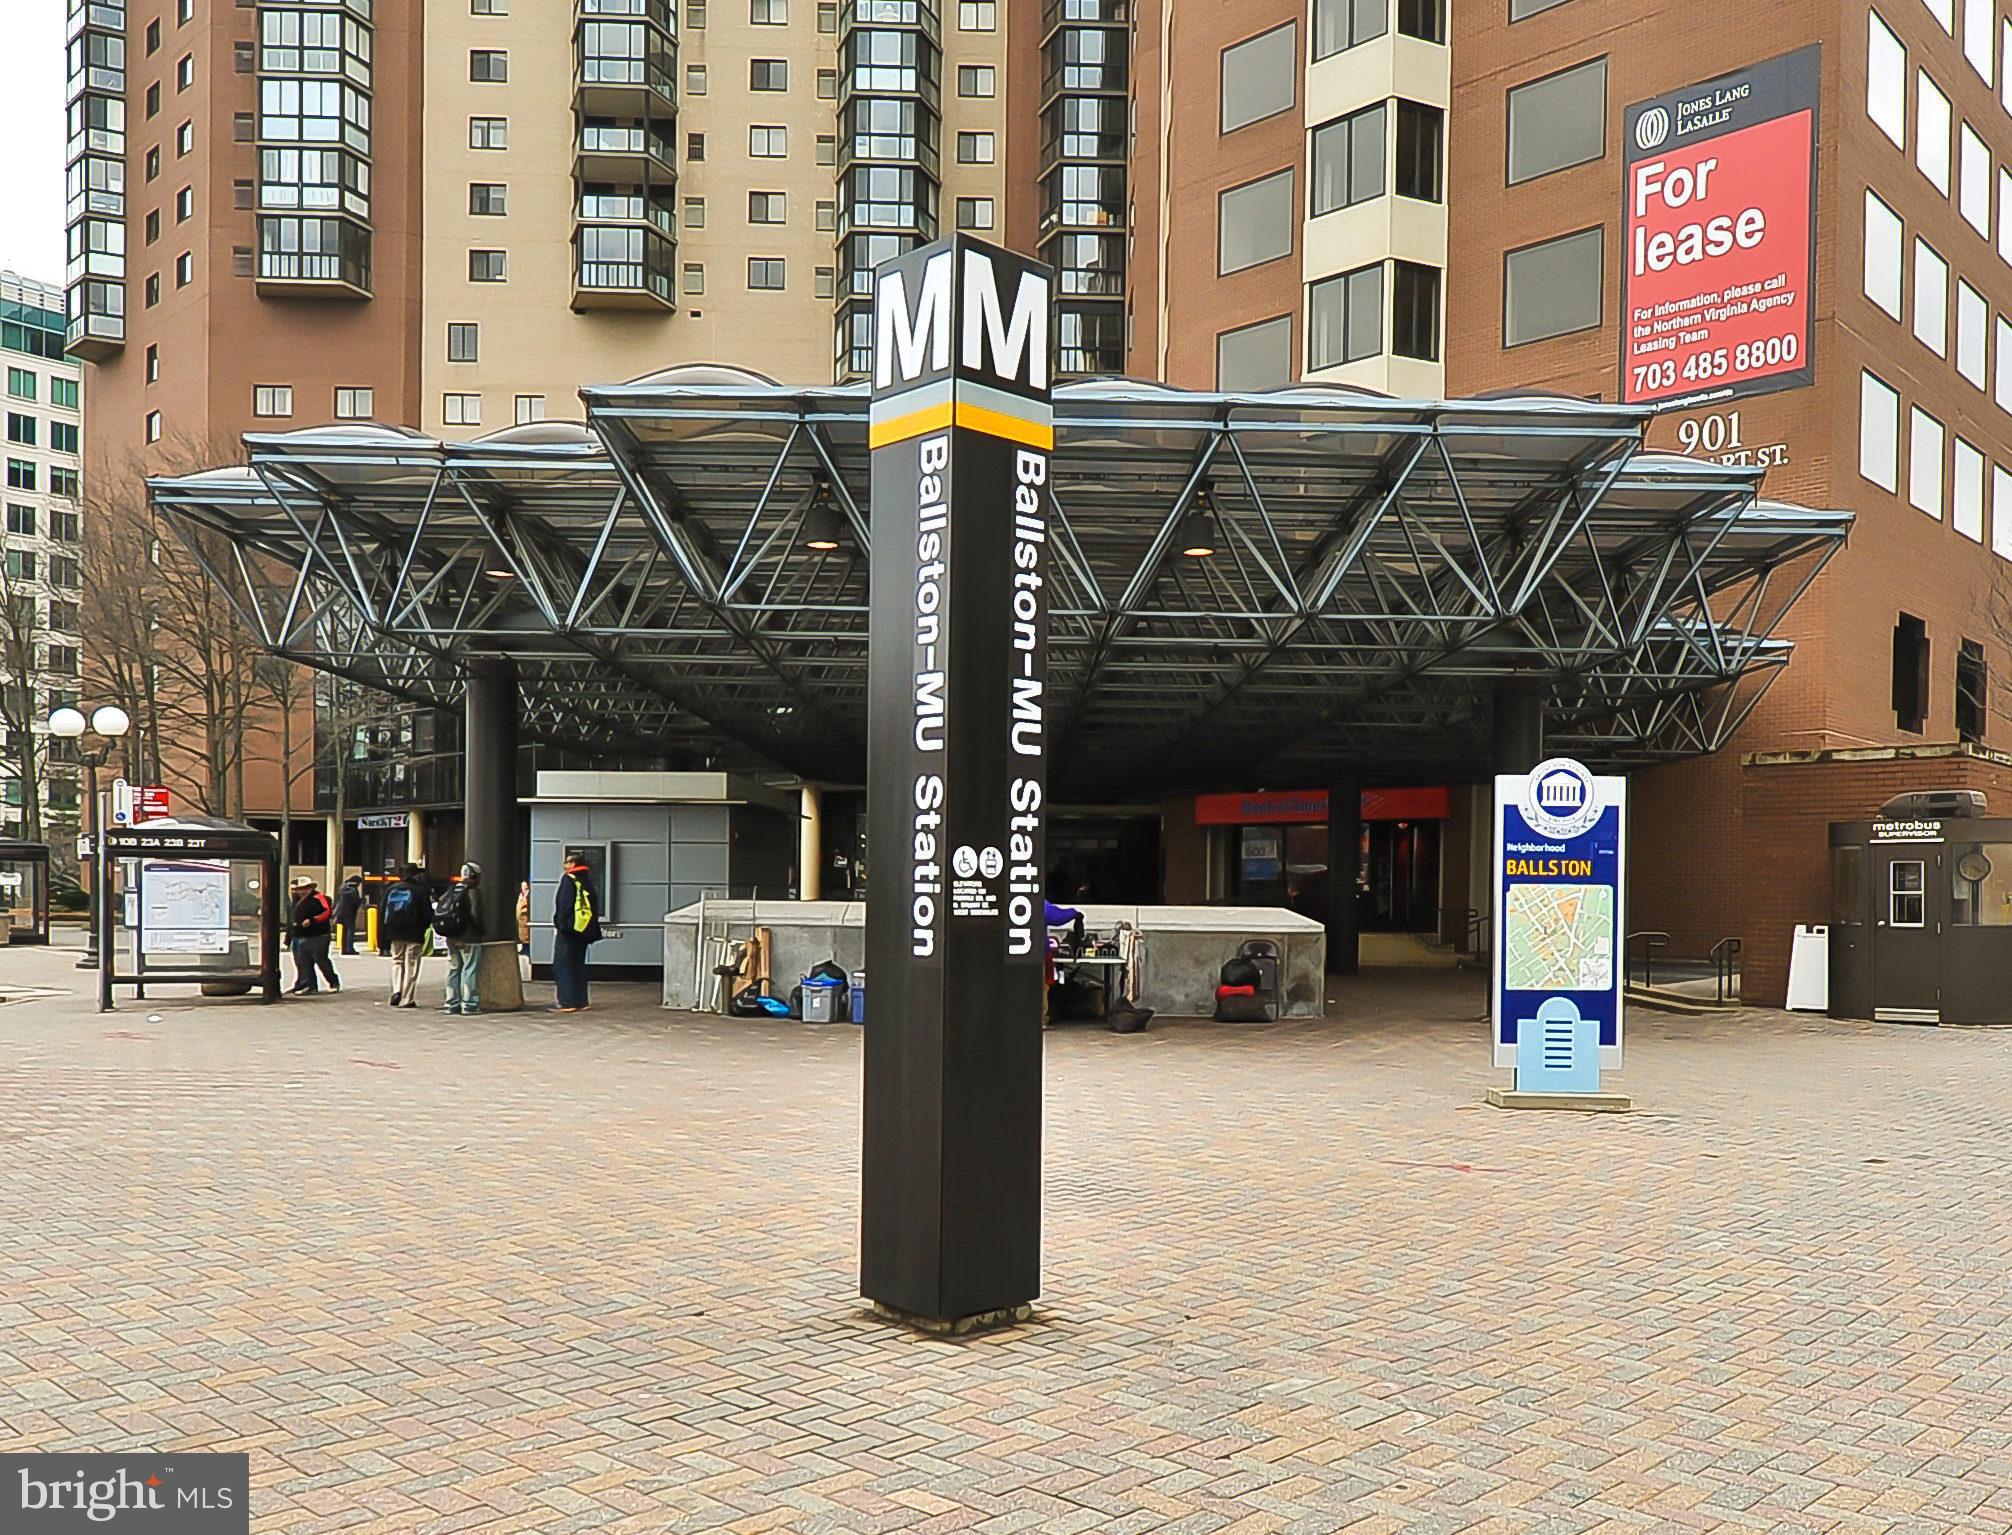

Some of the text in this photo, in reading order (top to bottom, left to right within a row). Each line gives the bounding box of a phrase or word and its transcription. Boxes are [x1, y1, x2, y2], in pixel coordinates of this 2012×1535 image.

[1677, 84, 1750, 120] JONES LANG
[1635, 157, 1718, 218] For
[1634, 206, 1767, 277] lease
[875, 250, 951, 391] M
[962, 248, 1048, 391] M
[1633, 291, 1795, 338] the Northern Virginia Agency
[1634, 308, 1653, 321] For
[1723, 282, 1762, 303] please
[1764, 273, 1786, 290] call
[1633, 329, 1709, 355] Leasing Team
[1633, 334, 1798, 393] 703 485 8800
[1679, 411, 1742, 456] 901
[1506, 842, 1566, 853] Neighborhood
[1872, 821, 1941, 831] metrobus
[913, 775, 944, 956] Station
[1008, 777, 1042, 956] Station
[1506, 860, 1591, 876] BALLSTON
